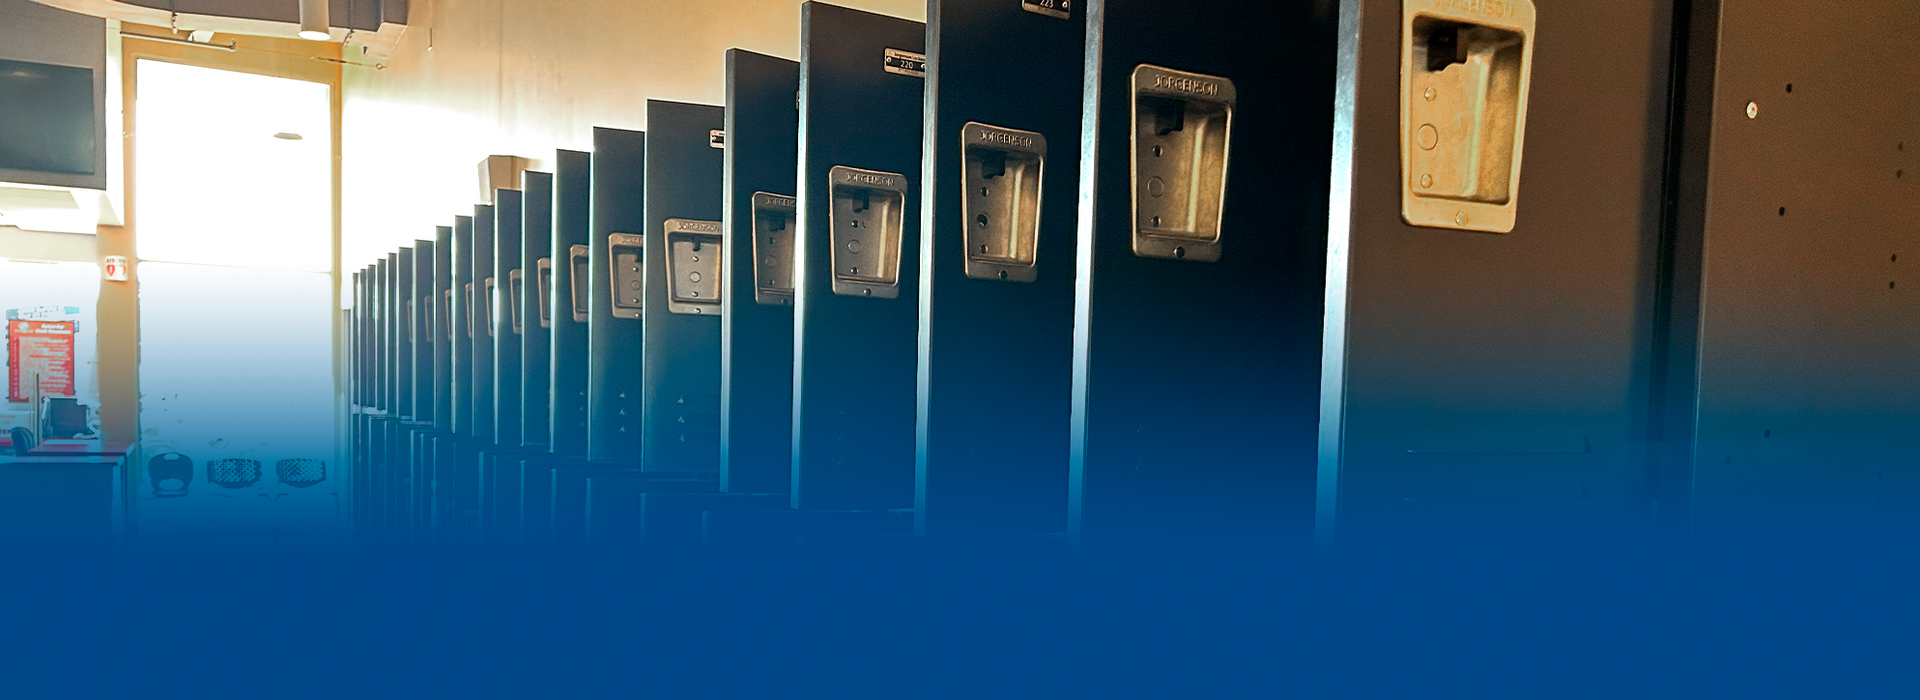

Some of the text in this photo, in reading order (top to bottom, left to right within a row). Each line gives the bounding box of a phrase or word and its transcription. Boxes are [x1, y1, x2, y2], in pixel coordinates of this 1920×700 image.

[1040, 0, 1054, 8] 223
[900, 60, 914, 70] 220
[1154, 74, 1219, 96] JORGENSON
[980, 130, 1032, 148] JORGENSON
[845, 172, 895, 187] JORGENSON
